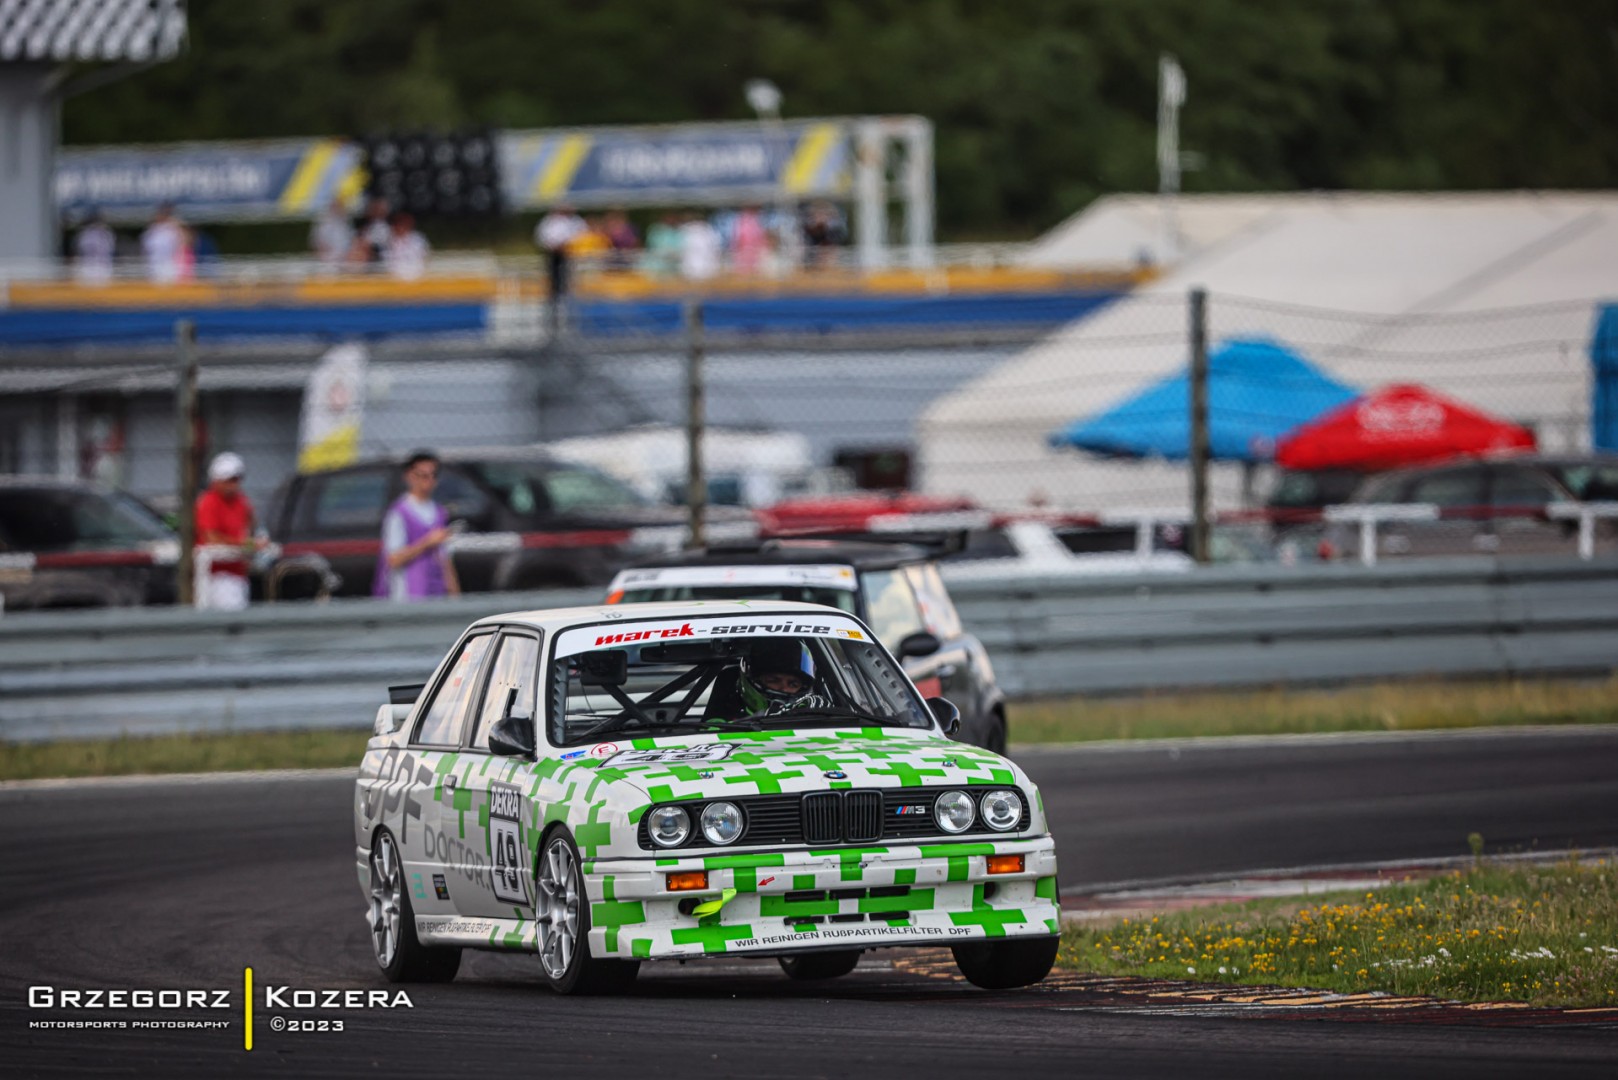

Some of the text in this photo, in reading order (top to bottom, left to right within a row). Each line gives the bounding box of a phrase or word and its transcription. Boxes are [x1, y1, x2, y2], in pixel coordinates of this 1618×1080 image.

[490, 785, 520, 818] DEKRA
[896, 805, 926, 815] M3
[494, 828, 520, 893] 49
[735, 938, 759, 947] WIR
[762, 931, 820, 945] REINIGEN
[948, 927, 972, 936] DPF
